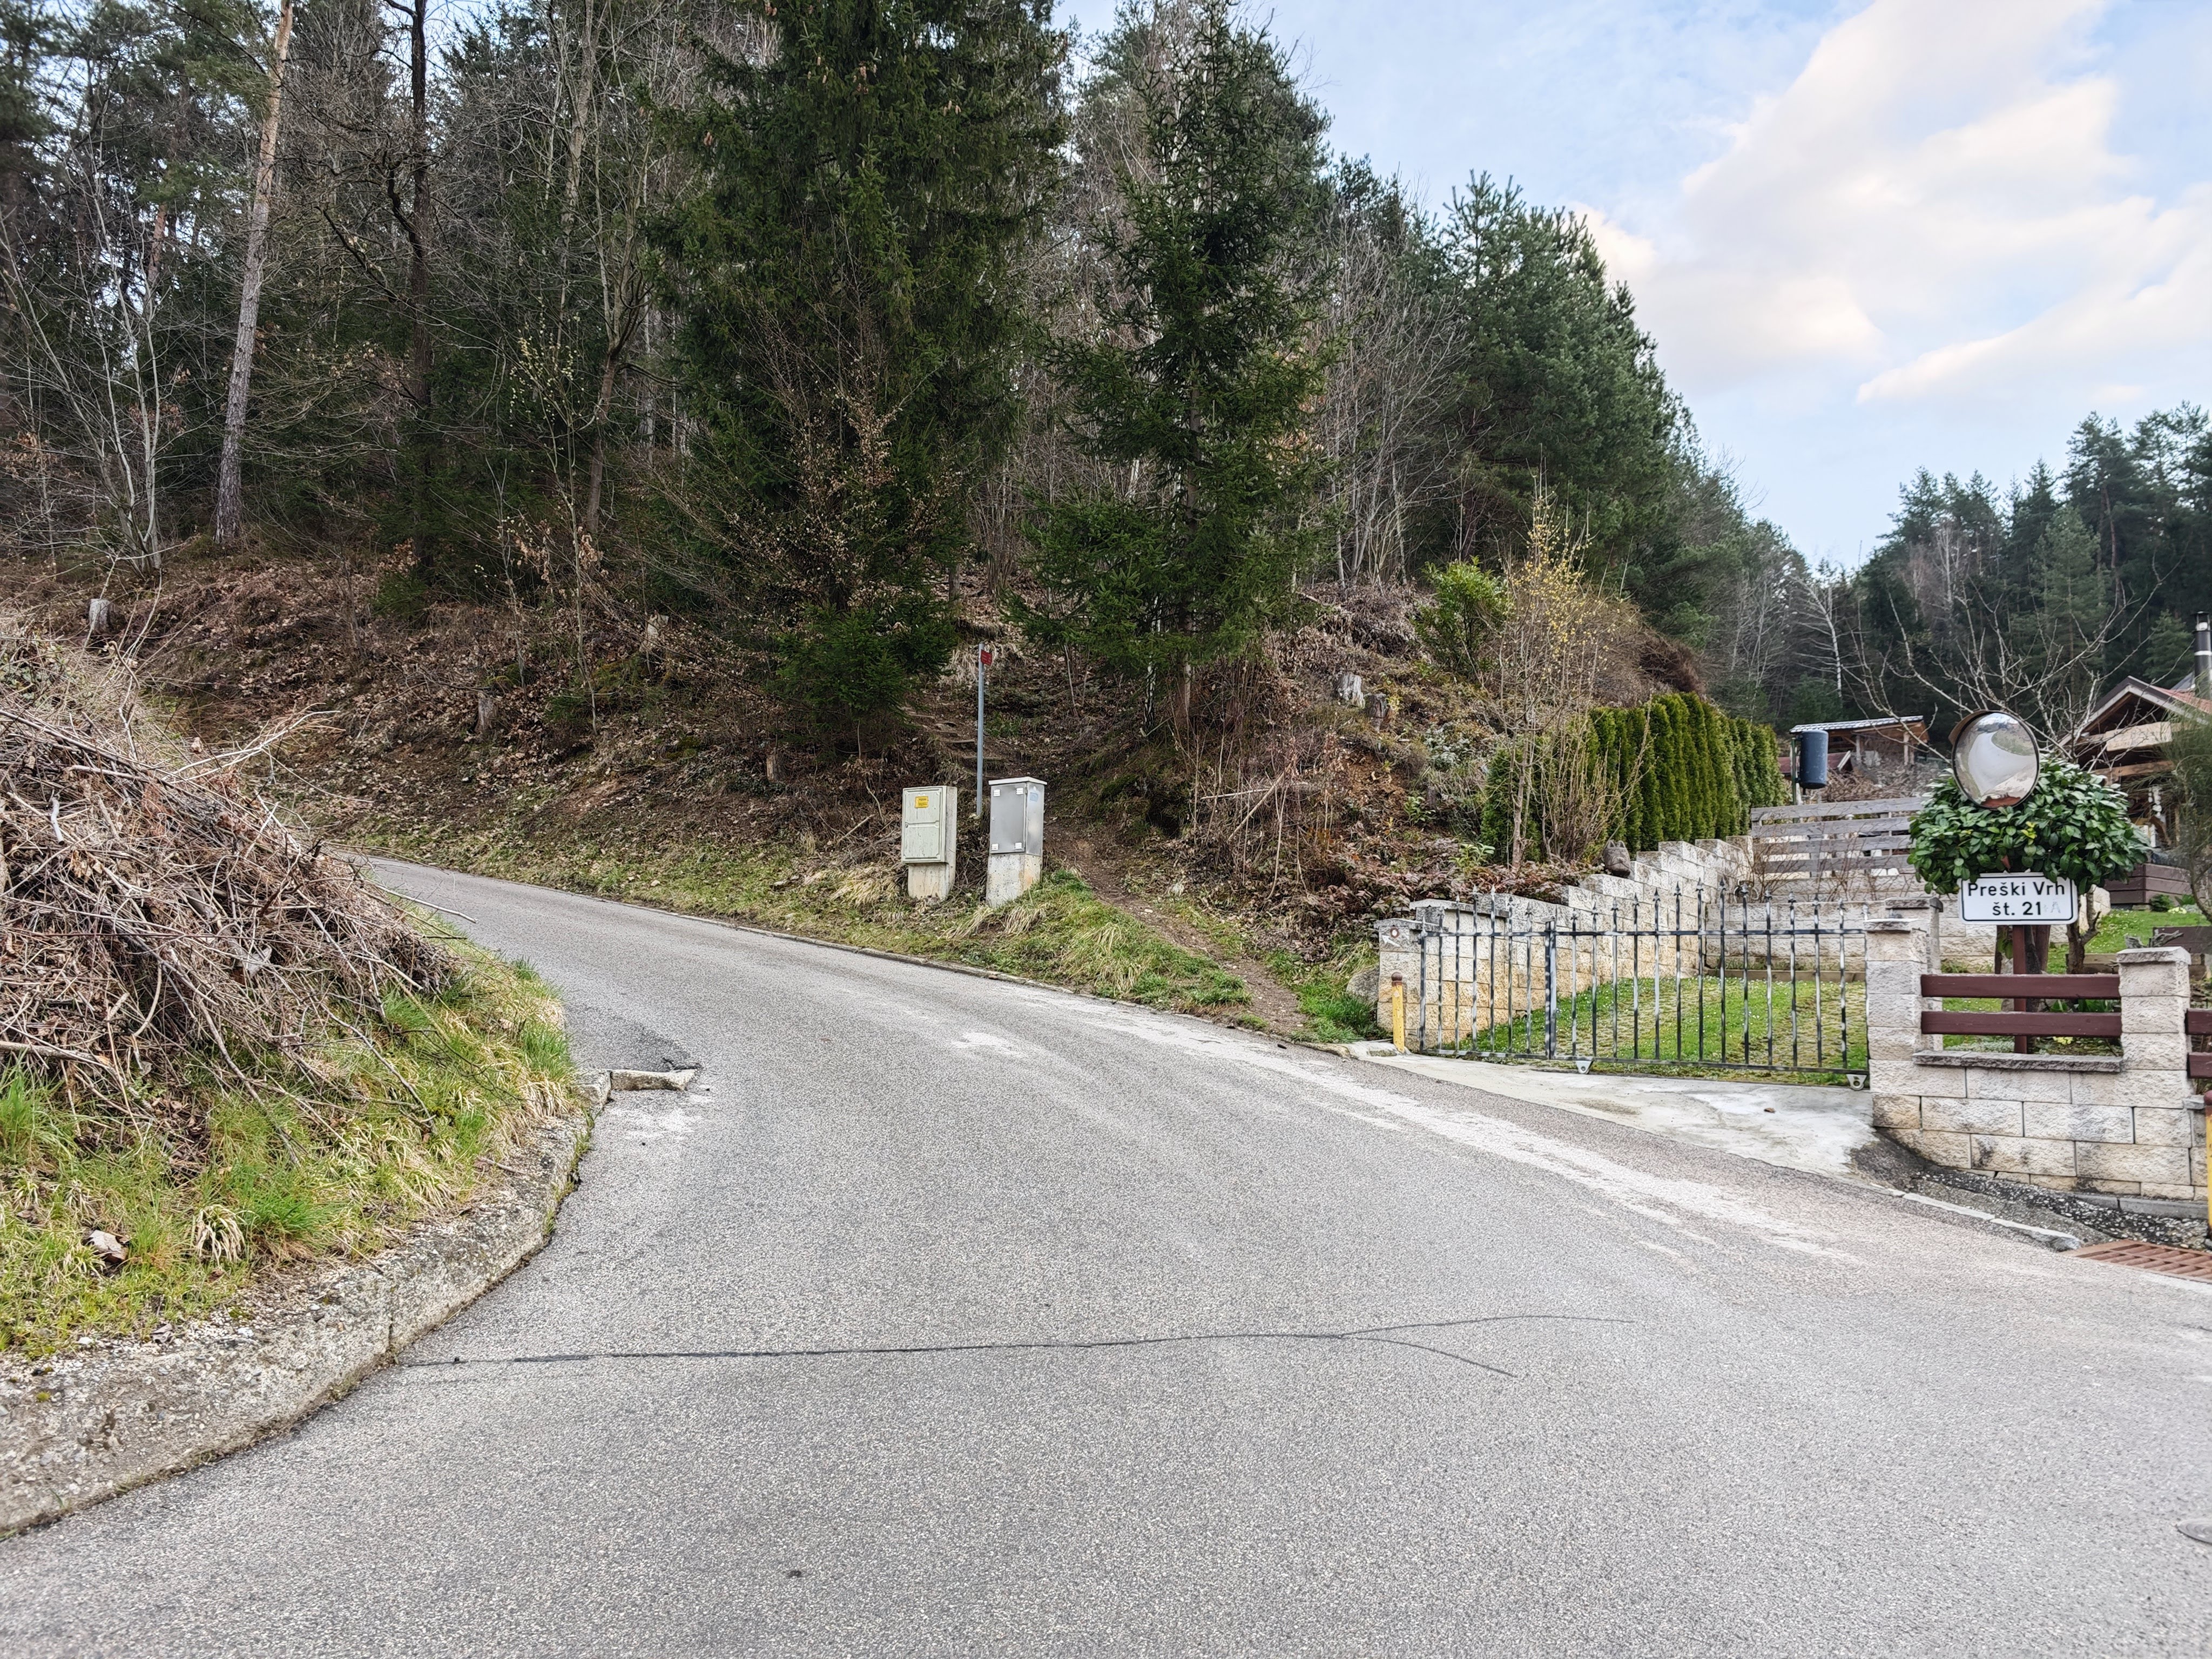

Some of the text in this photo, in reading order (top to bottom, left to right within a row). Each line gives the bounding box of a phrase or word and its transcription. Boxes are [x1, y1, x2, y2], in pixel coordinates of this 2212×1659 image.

[1967, 881, 2065, 896] Preški Vrh
[1992, 901, 2015, 916] št.
[2021, 901, 2041, 915] 21
